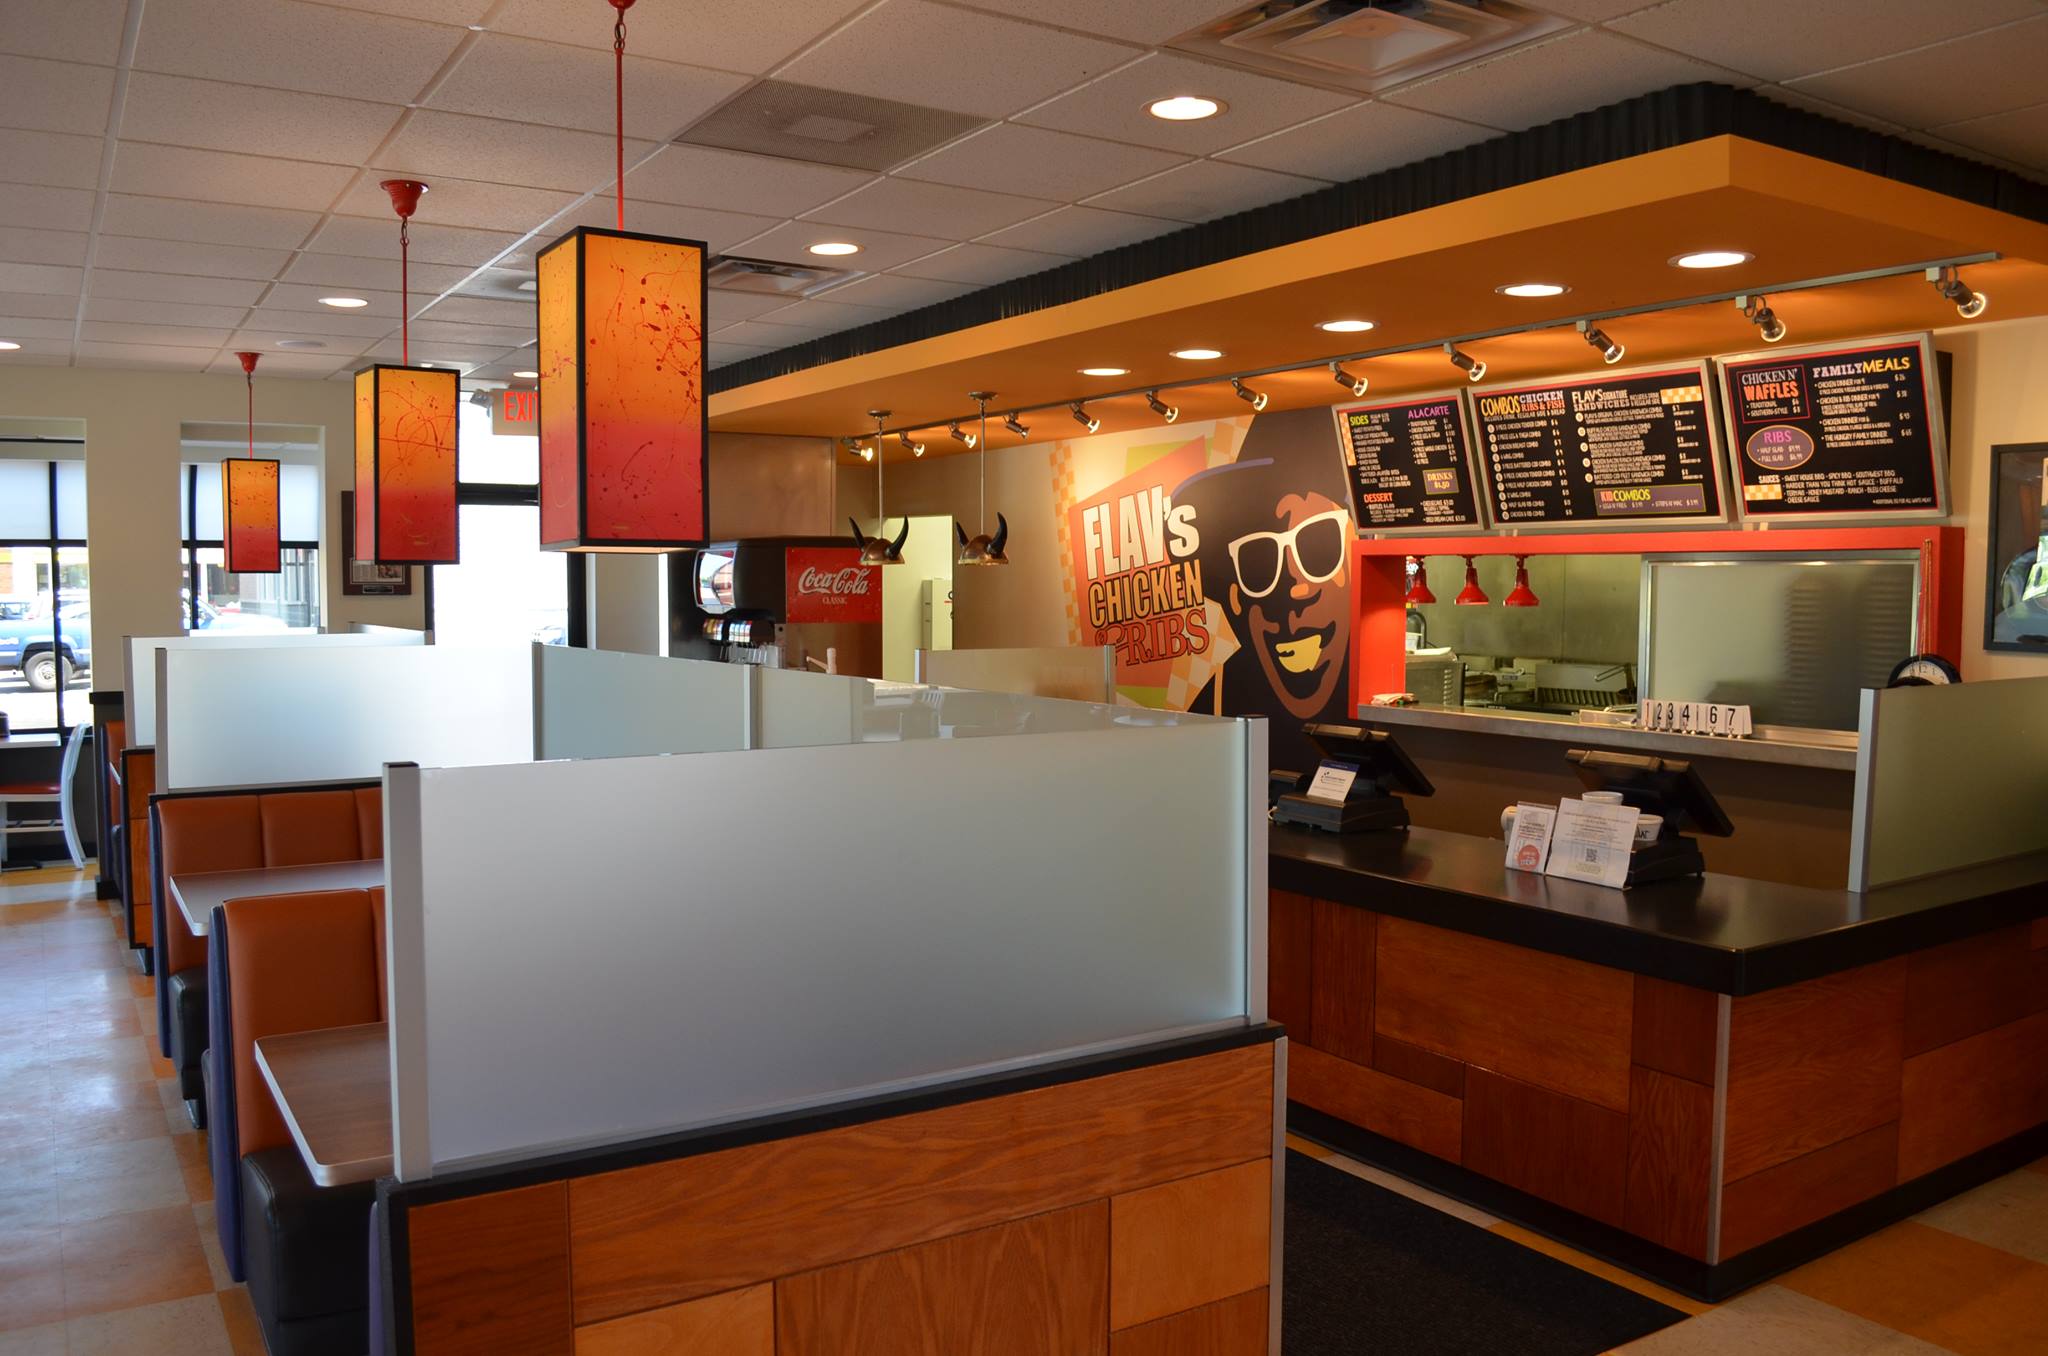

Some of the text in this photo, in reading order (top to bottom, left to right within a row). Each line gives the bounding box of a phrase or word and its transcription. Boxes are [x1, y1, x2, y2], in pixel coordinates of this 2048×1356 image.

[1812, 357, 1910, 378] FAMILY MEALS
[1741, 370, 1786, 385] CHICKEN
[1743, 380, 1799, 402] WAFFLES
[1481, 390, 1564, 416] COMBOS CHICKEN
[1546, 400, 1566, 410] FISH
[1350, 414, 1370, 426] SIDES
[1763, 431, 1792, 444] RIBS
[1427, 472, 1454, 481] DRINKS
[1363, 492, 1394, 503] DESSERT
[1613, 489, 1650, 502] COMBOS
[799, 566, 872, 594] Coca-Cola
[1088, 559, 1205, 628] CHICKEN
[1657, 702, 1664, 721] 2
[1668, 702, 1674, 721] 3
[1682, 704, 1690, 722] 4
[1710, 706, 1718, 724] 6
[1728, 708, 1736, 726] 7
